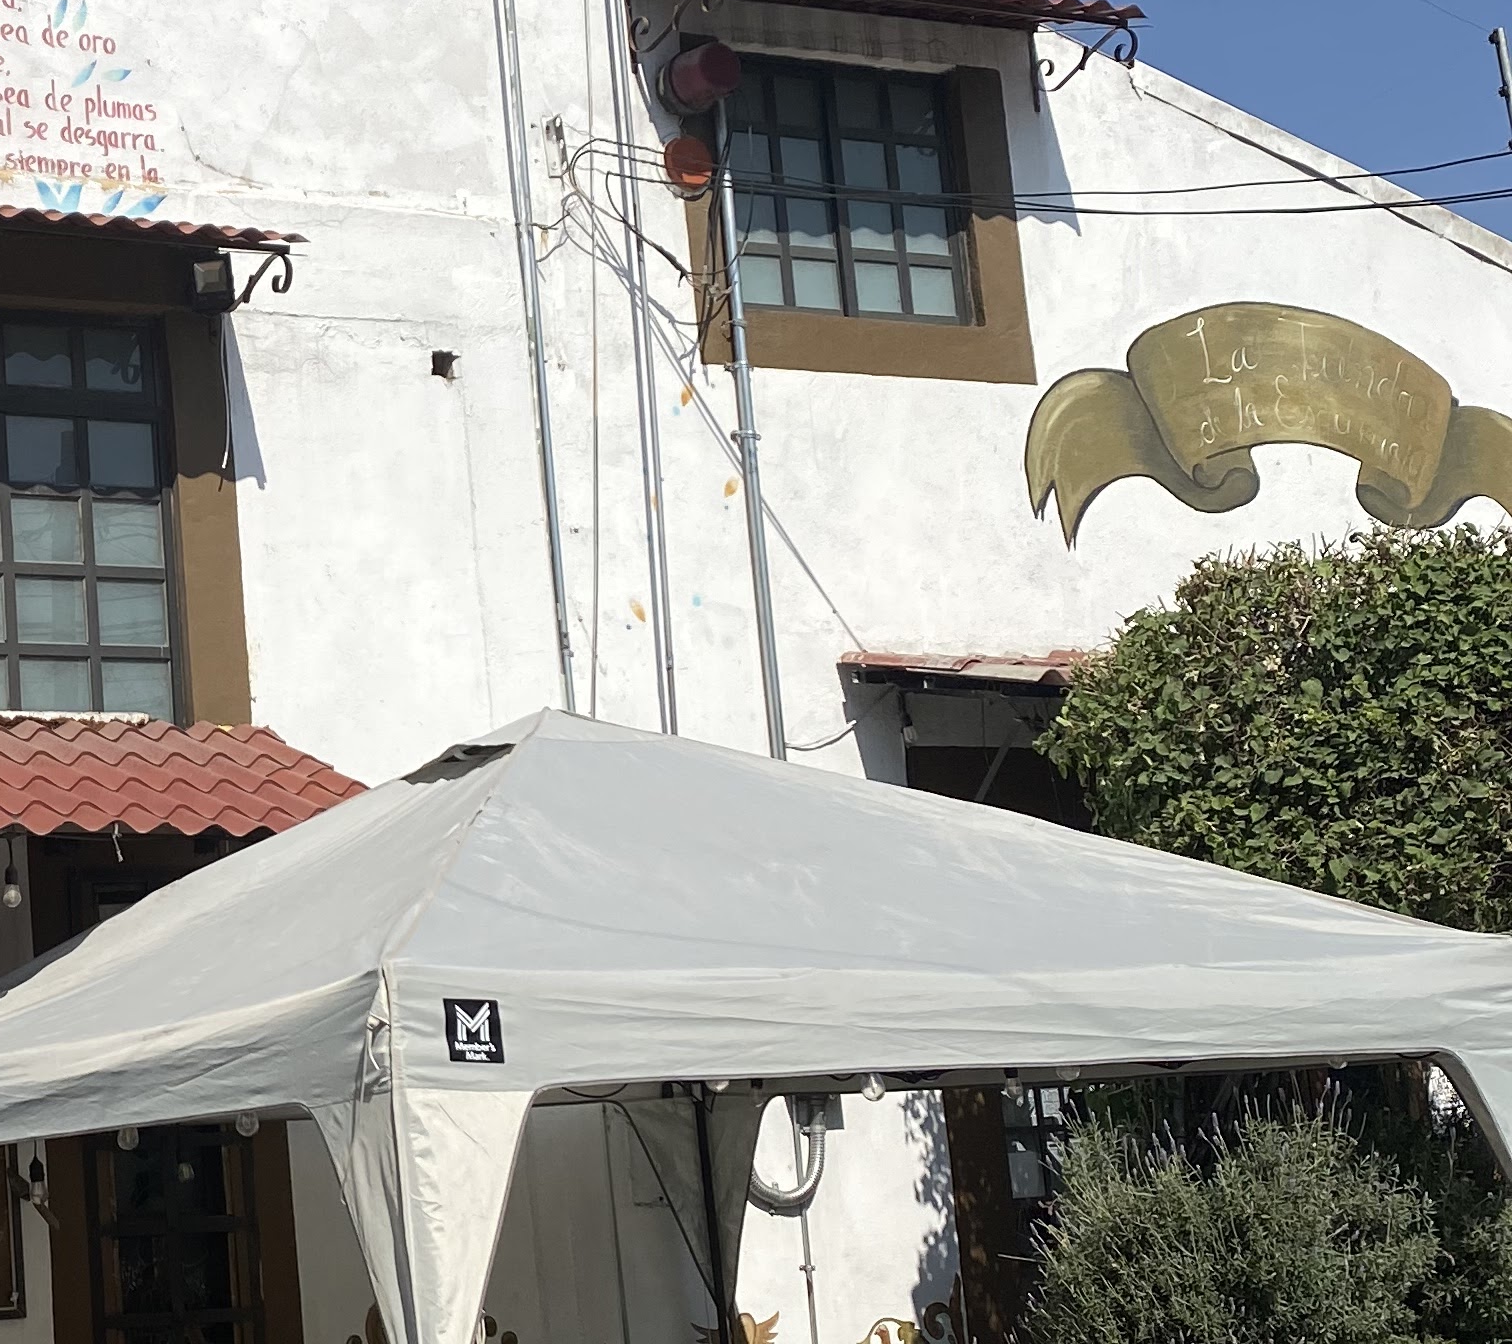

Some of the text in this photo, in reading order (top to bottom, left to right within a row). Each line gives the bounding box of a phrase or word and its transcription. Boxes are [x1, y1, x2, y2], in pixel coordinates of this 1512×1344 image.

[41, 14, 69, 49] de
[78, 31, 117, 56] oro
[45, 79, 73, 113] de
[85, 83, 157, 125] plumas
[23, 118, 48, 141] se
[60, 116, 165, 156] desgarra.
[5, 149, 93, 178] siempre
[105, 161, 131, 183] en
[1186, 317, 1258, 384] La
